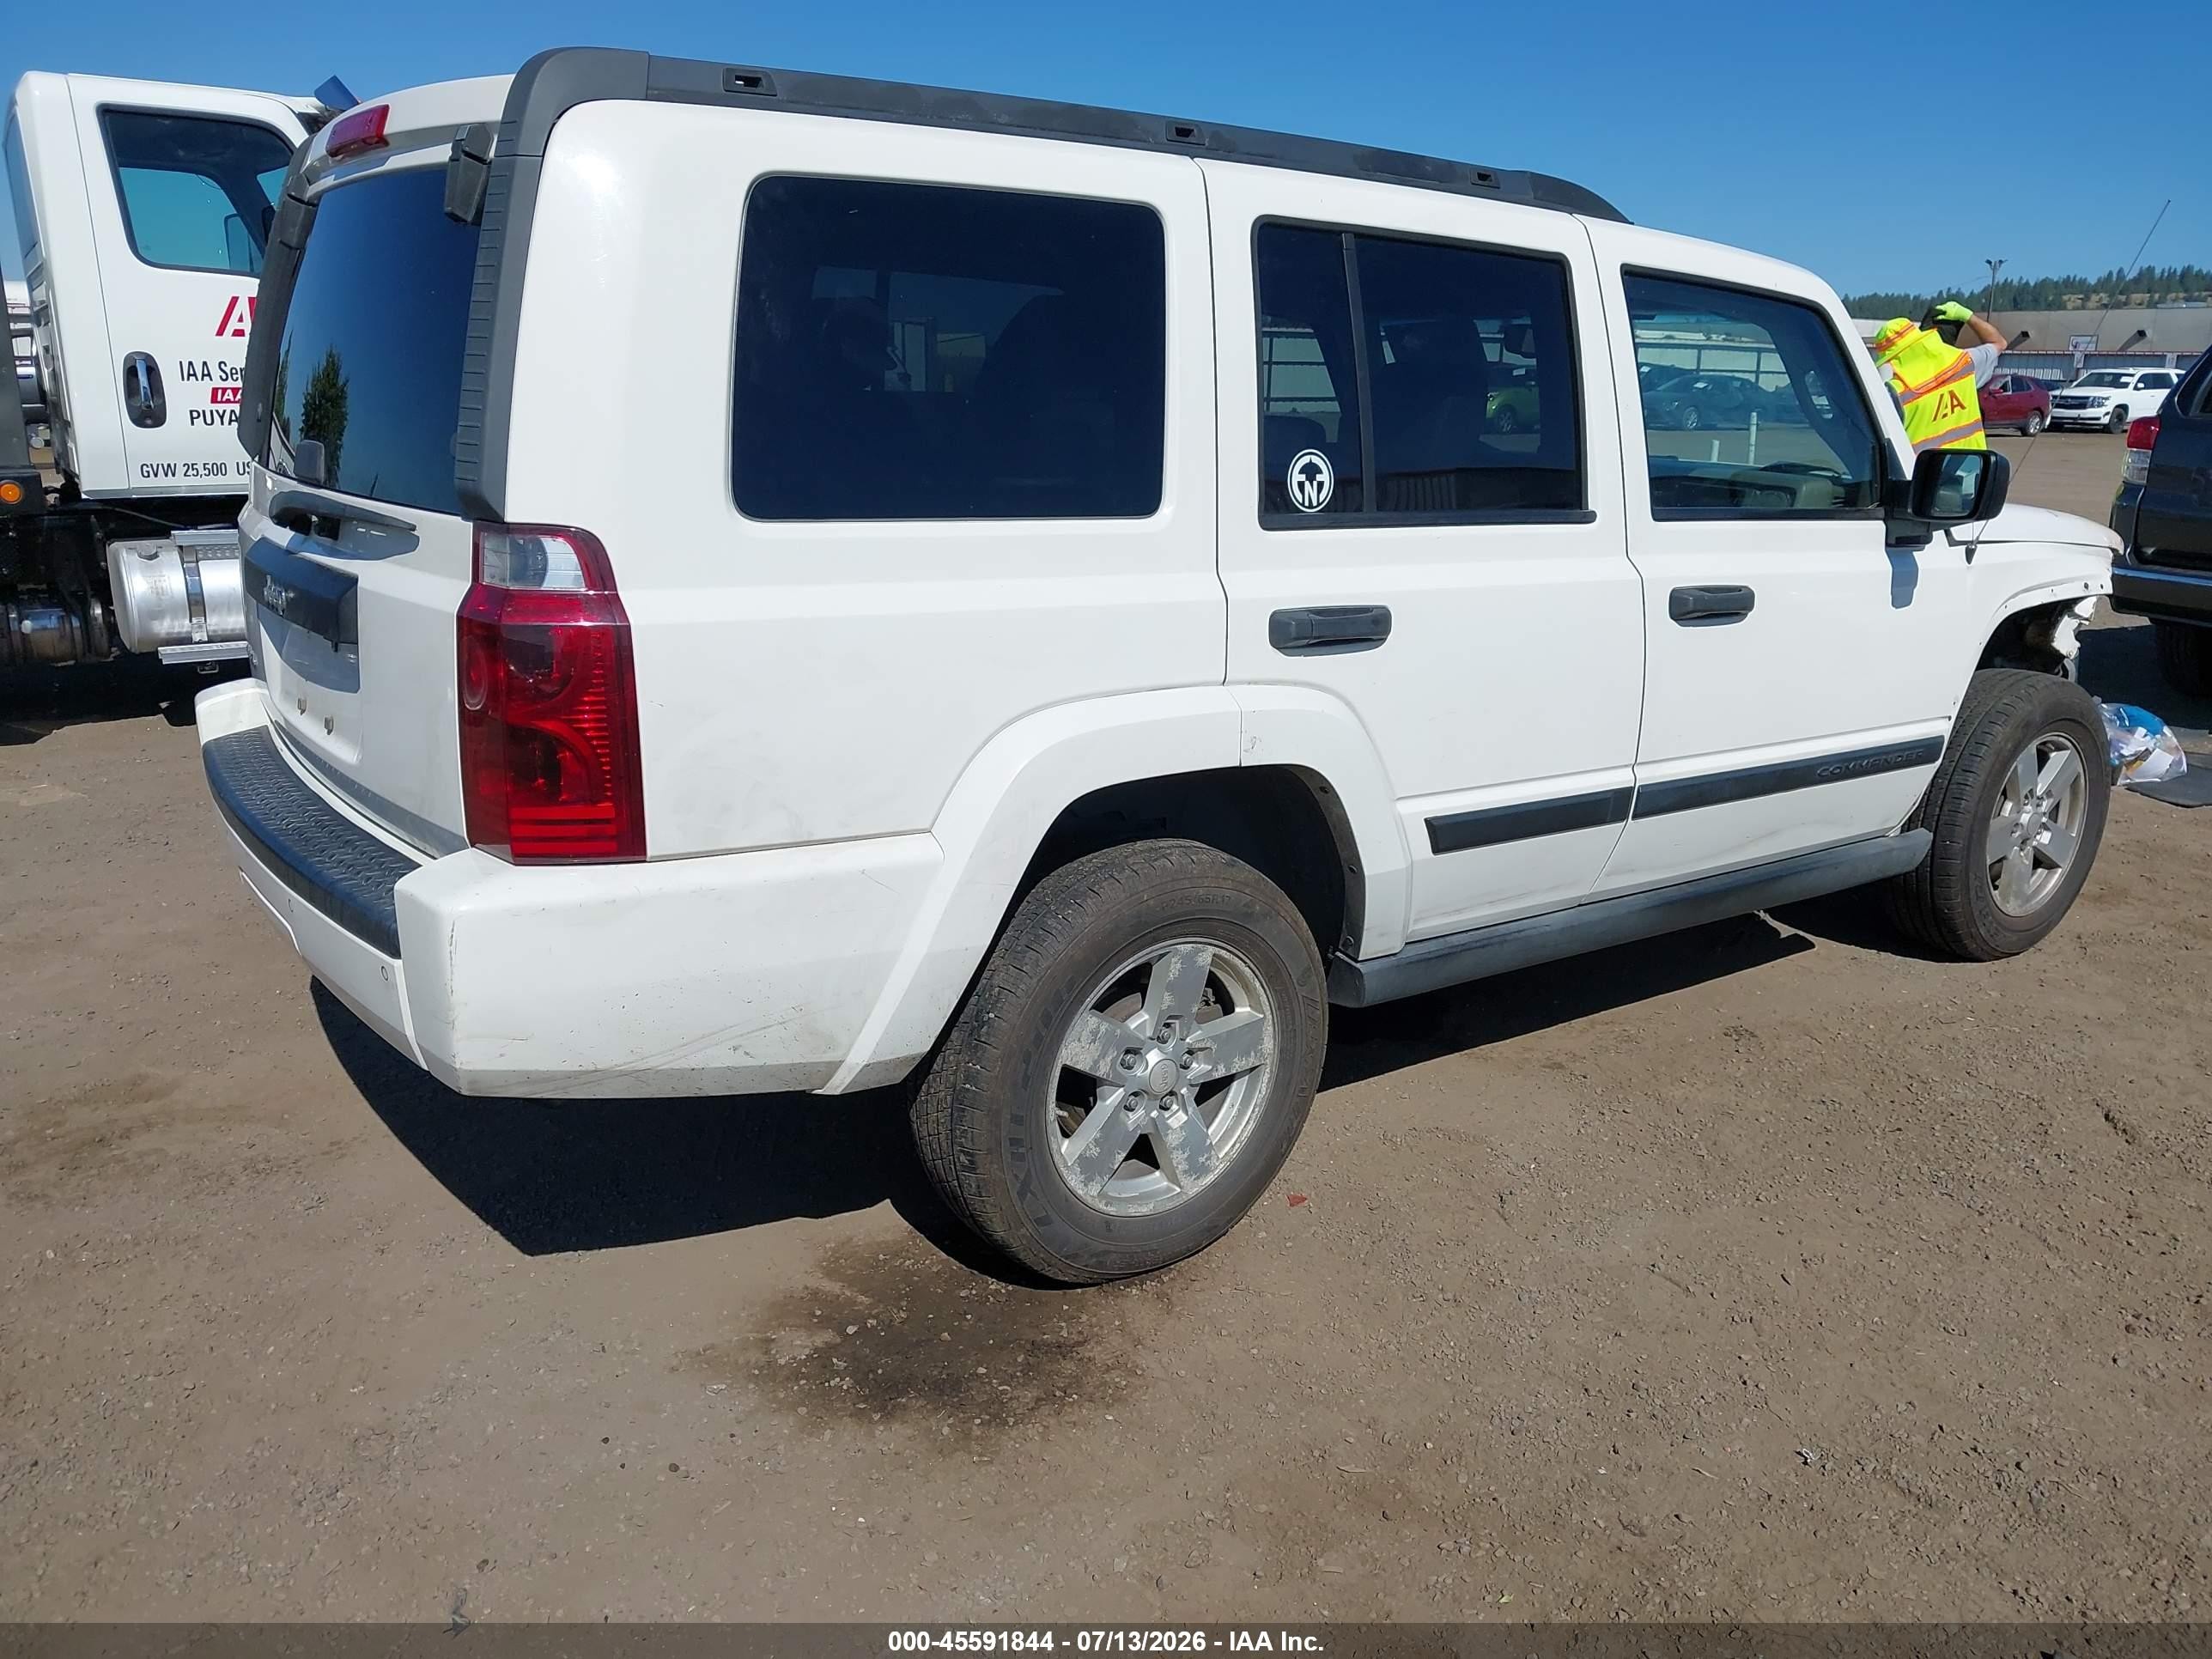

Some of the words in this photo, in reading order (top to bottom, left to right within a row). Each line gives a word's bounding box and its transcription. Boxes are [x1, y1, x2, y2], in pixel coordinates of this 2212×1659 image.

[179, 361, 213, 381] IAA
[189, 409, 239, 426] PUYA
[140, 463, 177, 478] GVW
[183, 462, 228, 478] 25,500
[1816, 749, 1924, 779] COMMANDER
